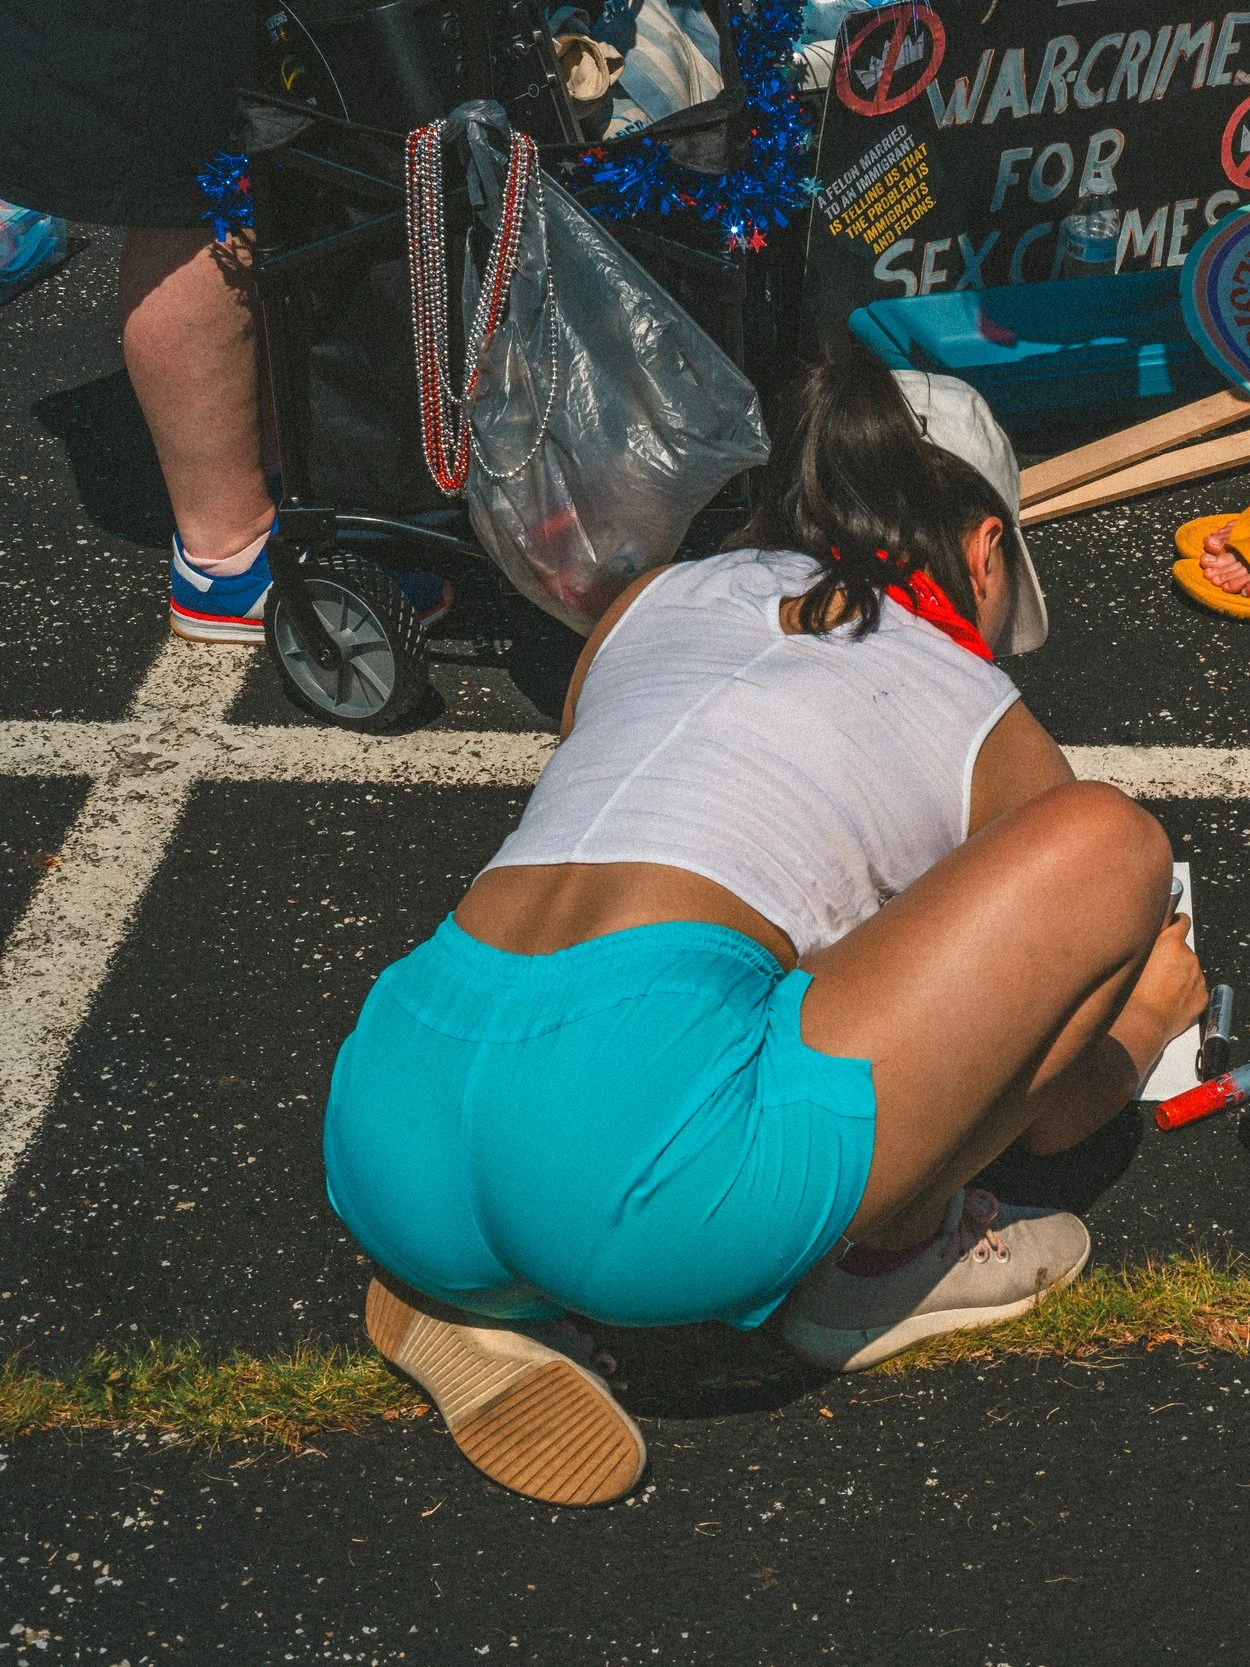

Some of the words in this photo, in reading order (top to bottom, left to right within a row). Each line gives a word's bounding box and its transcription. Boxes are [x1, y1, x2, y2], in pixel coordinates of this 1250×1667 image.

[817, 195, 827, 209] A
[825, 164, 860, 200] FELON
[859, 124, 907, 171] MARRIED
[823, 206, 841, 220] TO
[841, 187, 858, 209] AN
[855, 134, 916, 194] IMMIGRANT
[828, 219, 843, 236] IS
[841, 182, 885, 224] TELLING
[883, 167, 901, 187] US
[900, 142, 928, 173] THAT
[845, 215, 869, 240] THE
[867, 172, 917, 222] PROBLEM
[916, 162, 929, 180] IS
[989, 128, 1125, 212] FOR
[862, 181, 929, 244] IMMIGRANTS
[872, 230, 896, 255] AND
[894, 195, 937, 236] FELONS.
